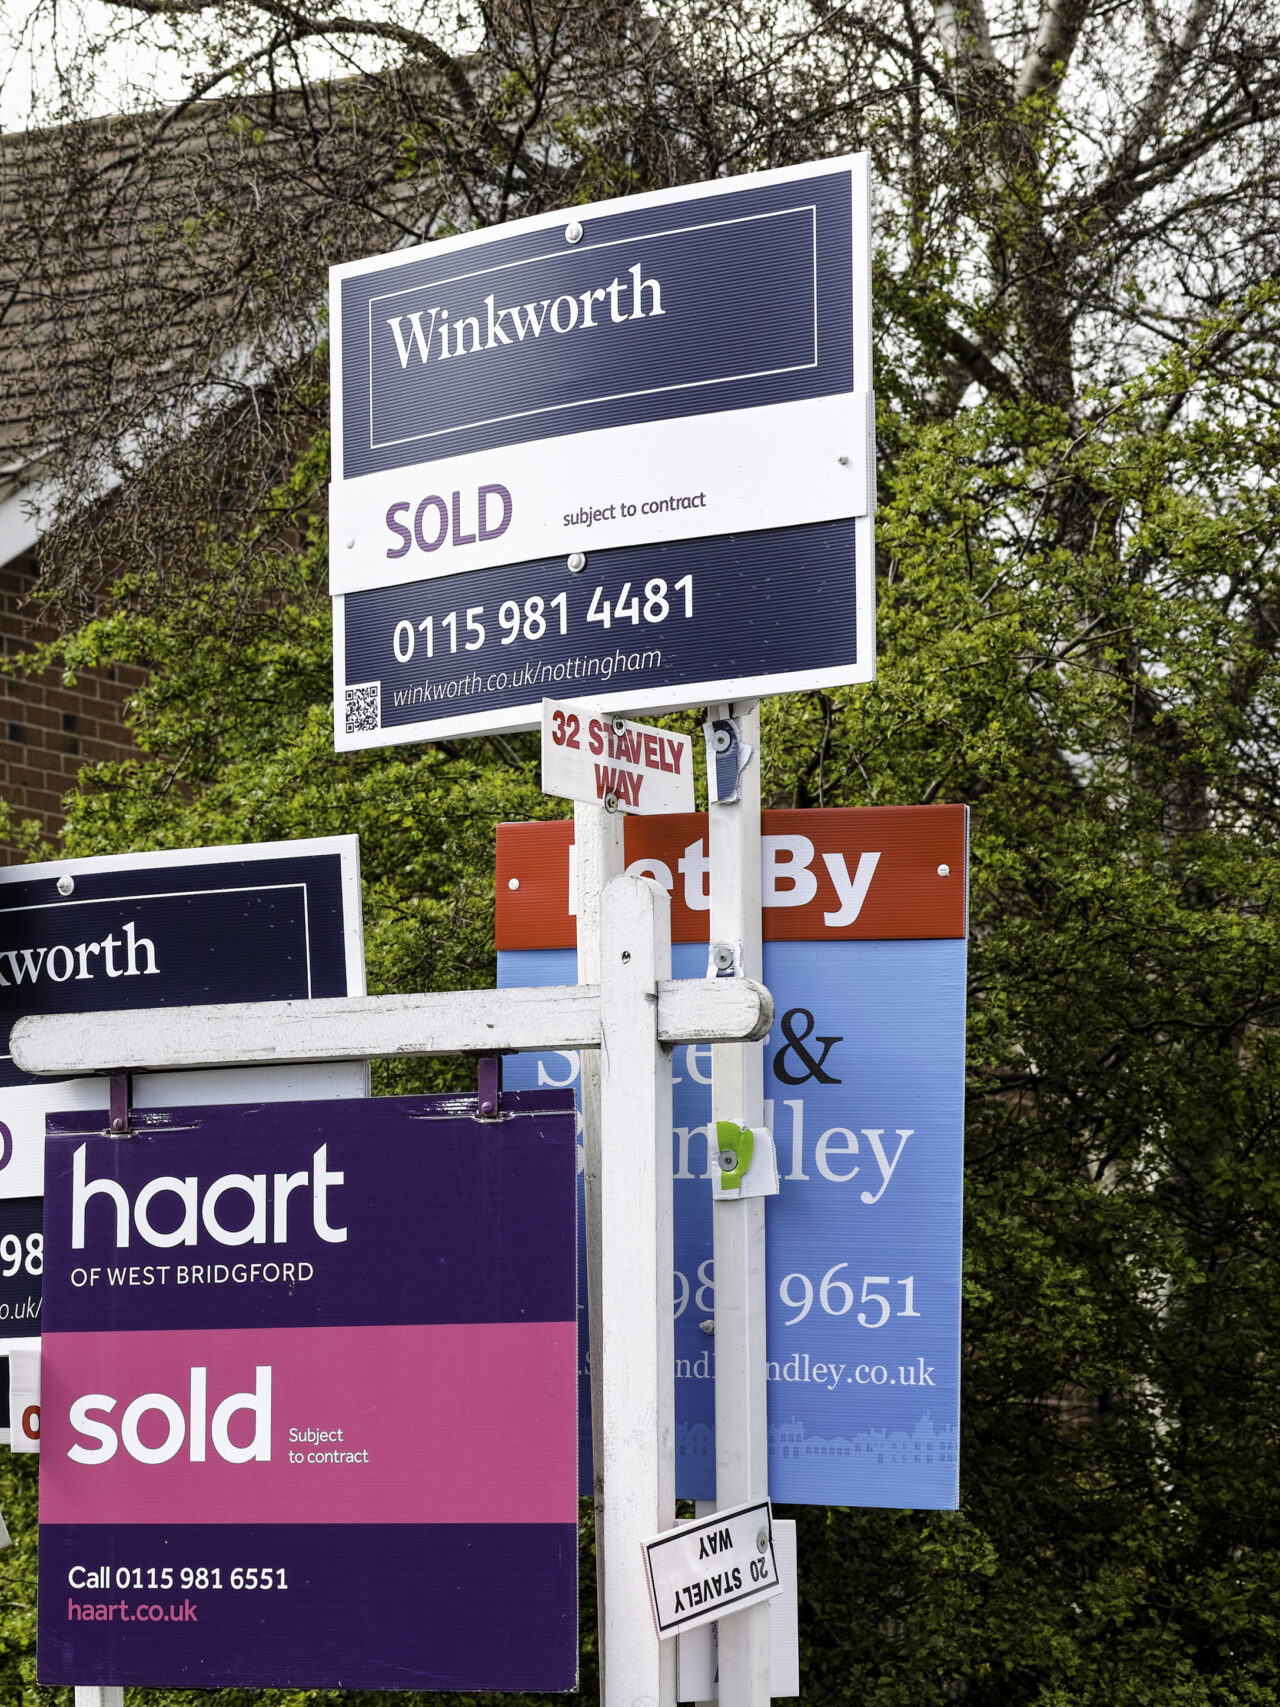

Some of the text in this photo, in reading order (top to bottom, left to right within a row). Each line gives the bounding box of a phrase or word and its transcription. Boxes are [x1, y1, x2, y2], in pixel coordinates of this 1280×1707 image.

[387, 262, 666, 369] Winkworth
[385, 483, 513, 560] SOLD
[563, 492, 707, 528] subject to contract
[393, 574, 694, 663] 0115 981 4481
[392, 646, 662, 708] winkworth.co.uk/nottingham
[552, 710, 685, 775] 32 STAVELY
[594, 763, 644, 808] WAY
[761, 834, 881, 927] By
[773, 1008, 843, 1085] &
[71, 1143, 348, 1249] haart
[71, 1262, 314, 1287] OF WEST BRIDGFORD
[779, 1262, 921, 1328] 9651
[67, 1366, 272, 1465] sold
[288, 1428, 344, 1444] Subject
[288, 1450, 369, 1464] to contract
[699, 1528, 733, 1560] WAY
[68, 1566, 288, 1589] Call 0115 981 6551
[675, 1556, 768, 1614] 20 STAVELY
[68, 1599, 198, 1622] haart.co.uk
